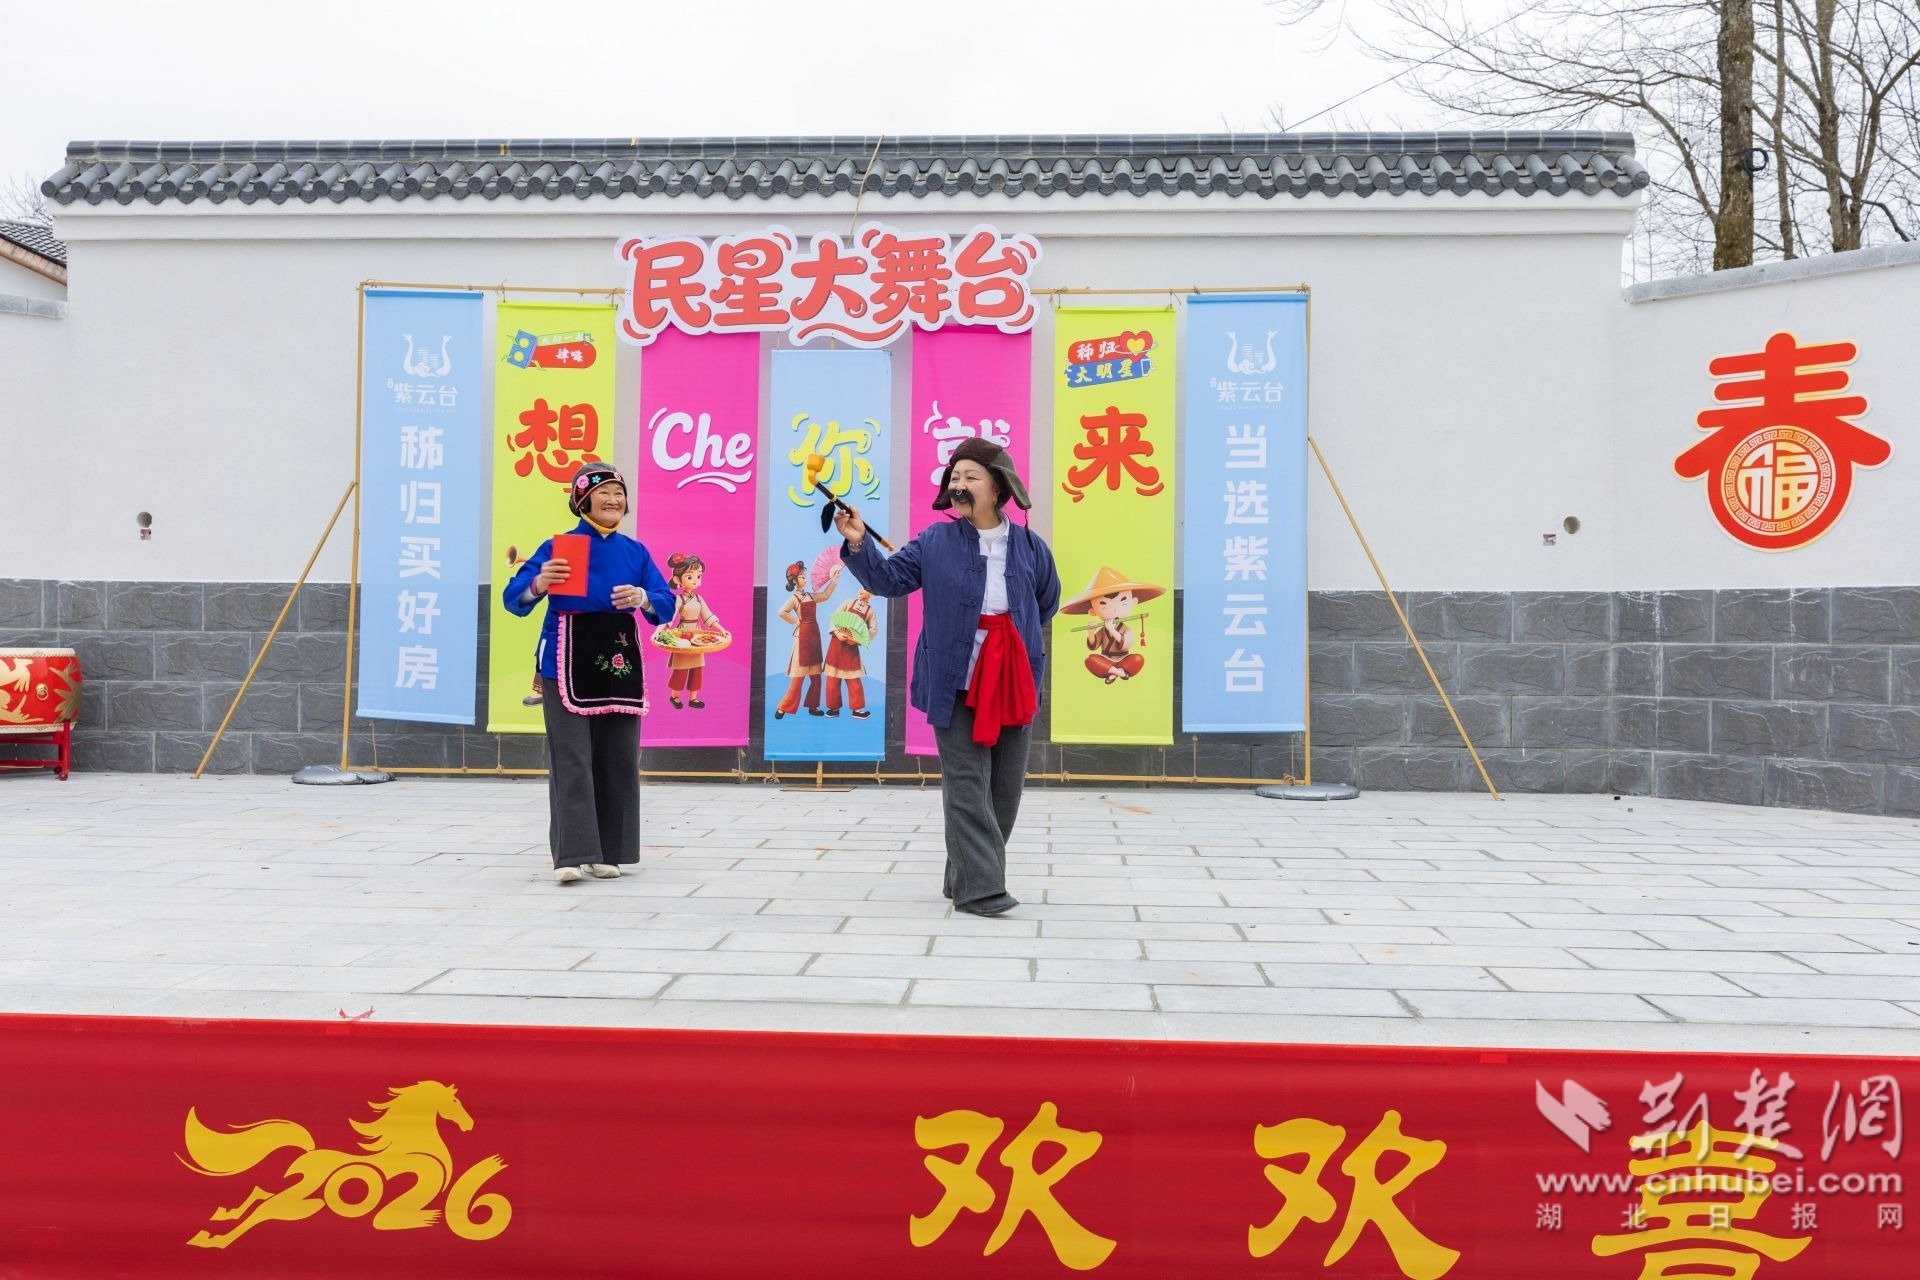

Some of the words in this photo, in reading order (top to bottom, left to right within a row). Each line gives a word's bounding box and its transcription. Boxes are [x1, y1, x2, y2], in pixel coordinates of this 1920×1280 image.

[633, 230, 1029, 329] 民星大舞台
[1074, 358, 1134, 384] 大明星
[1076, 341, 1117, 361] 秭归
[1216, 380, 1284, 403] 紫云台
[394, 382, 458, 406] 紫云台
[513, 397, 602, 484] 想
[651, 412, 755, 471] Che
[787, 420, 875, 497] 你
[1067, 405, 1160, 491] 来
[1674, 332, 1891, 549] 春
[1737, 441, 1820, 520] 福
[394, 425, 444, 690] 秭归买好房
[1223, 423, 1269, 693] 当选紫云台
[283, 1153, 513, 1241] 2026
